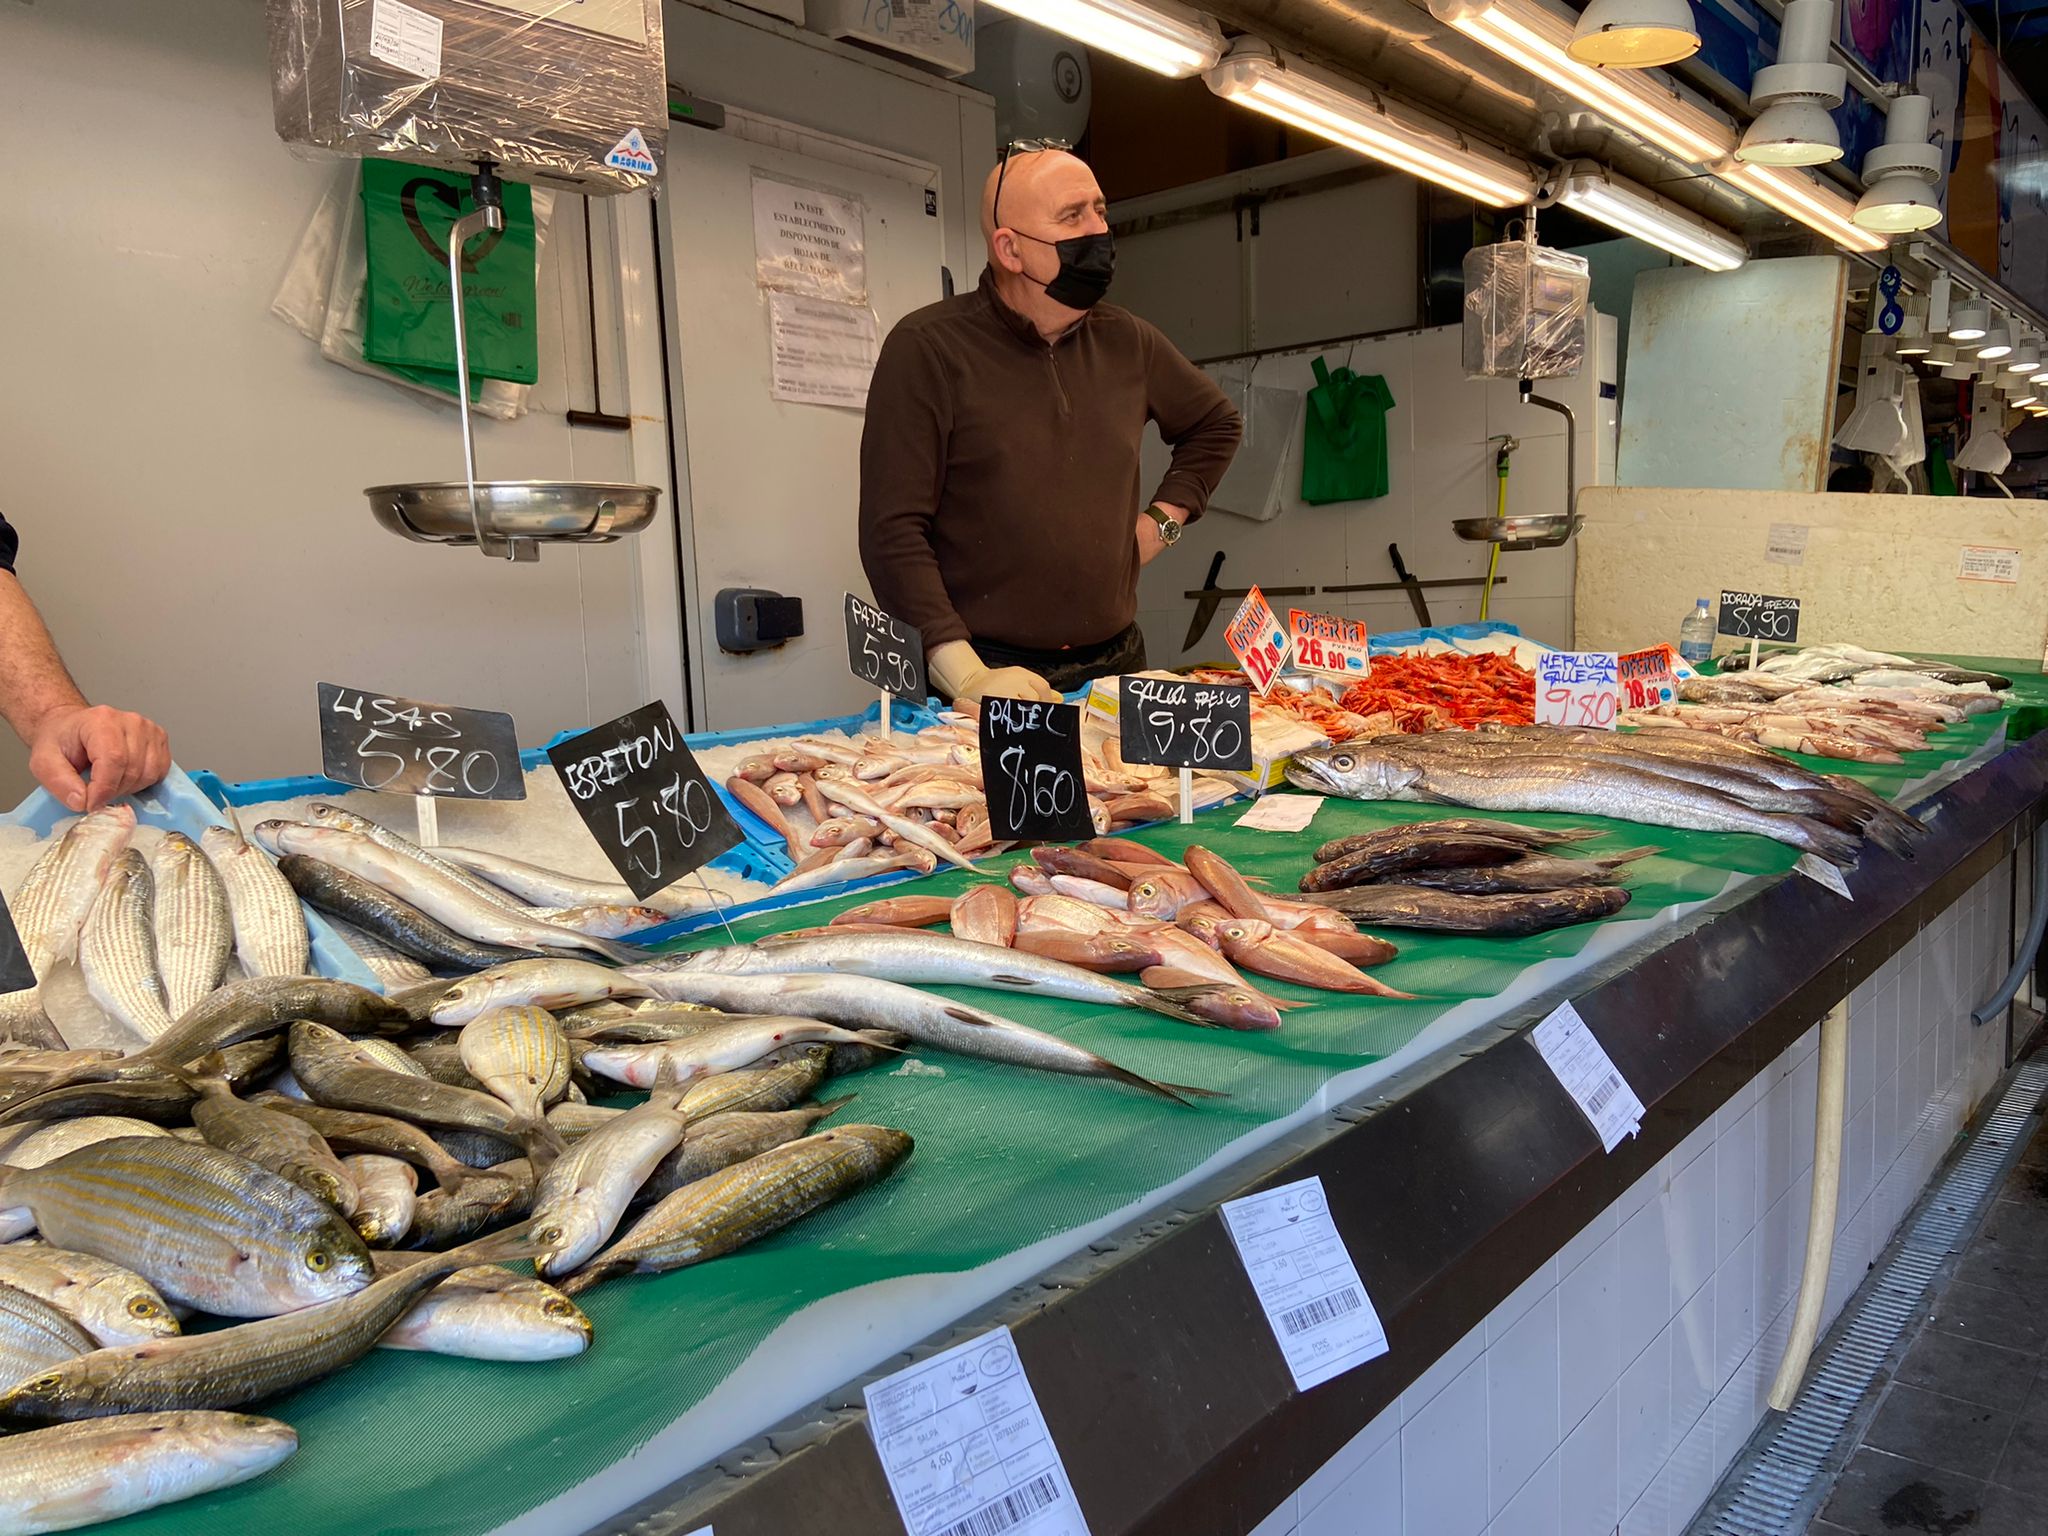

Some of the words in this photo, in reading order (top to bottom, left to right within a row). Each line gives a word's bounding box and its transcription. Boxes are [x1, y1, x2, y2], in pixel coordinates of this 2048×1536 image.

[794, 201, 806, 211] EN
[773, 212, 846, 236] ESTABLECIMIENTO
[780, 229, 832, 247] DISPONEMOS
[793, 247, 819, 260] HOJAS
[820, 252, 831, 262] DE
[1722, 593, 1763, 608] DORADA
[852, 598, 906, 643] PAJEL
[1297, 615, 1360, 643] OFERTA
[1540, 653, 1618, 671] MERLUZA
[1621, 655, 1667, 679] OFERTA
[989, 698, 1067, 739] PAJEL
[565, 718, 674, 800] ESPETON
[930, 1451, 954, 1472] 4,60
